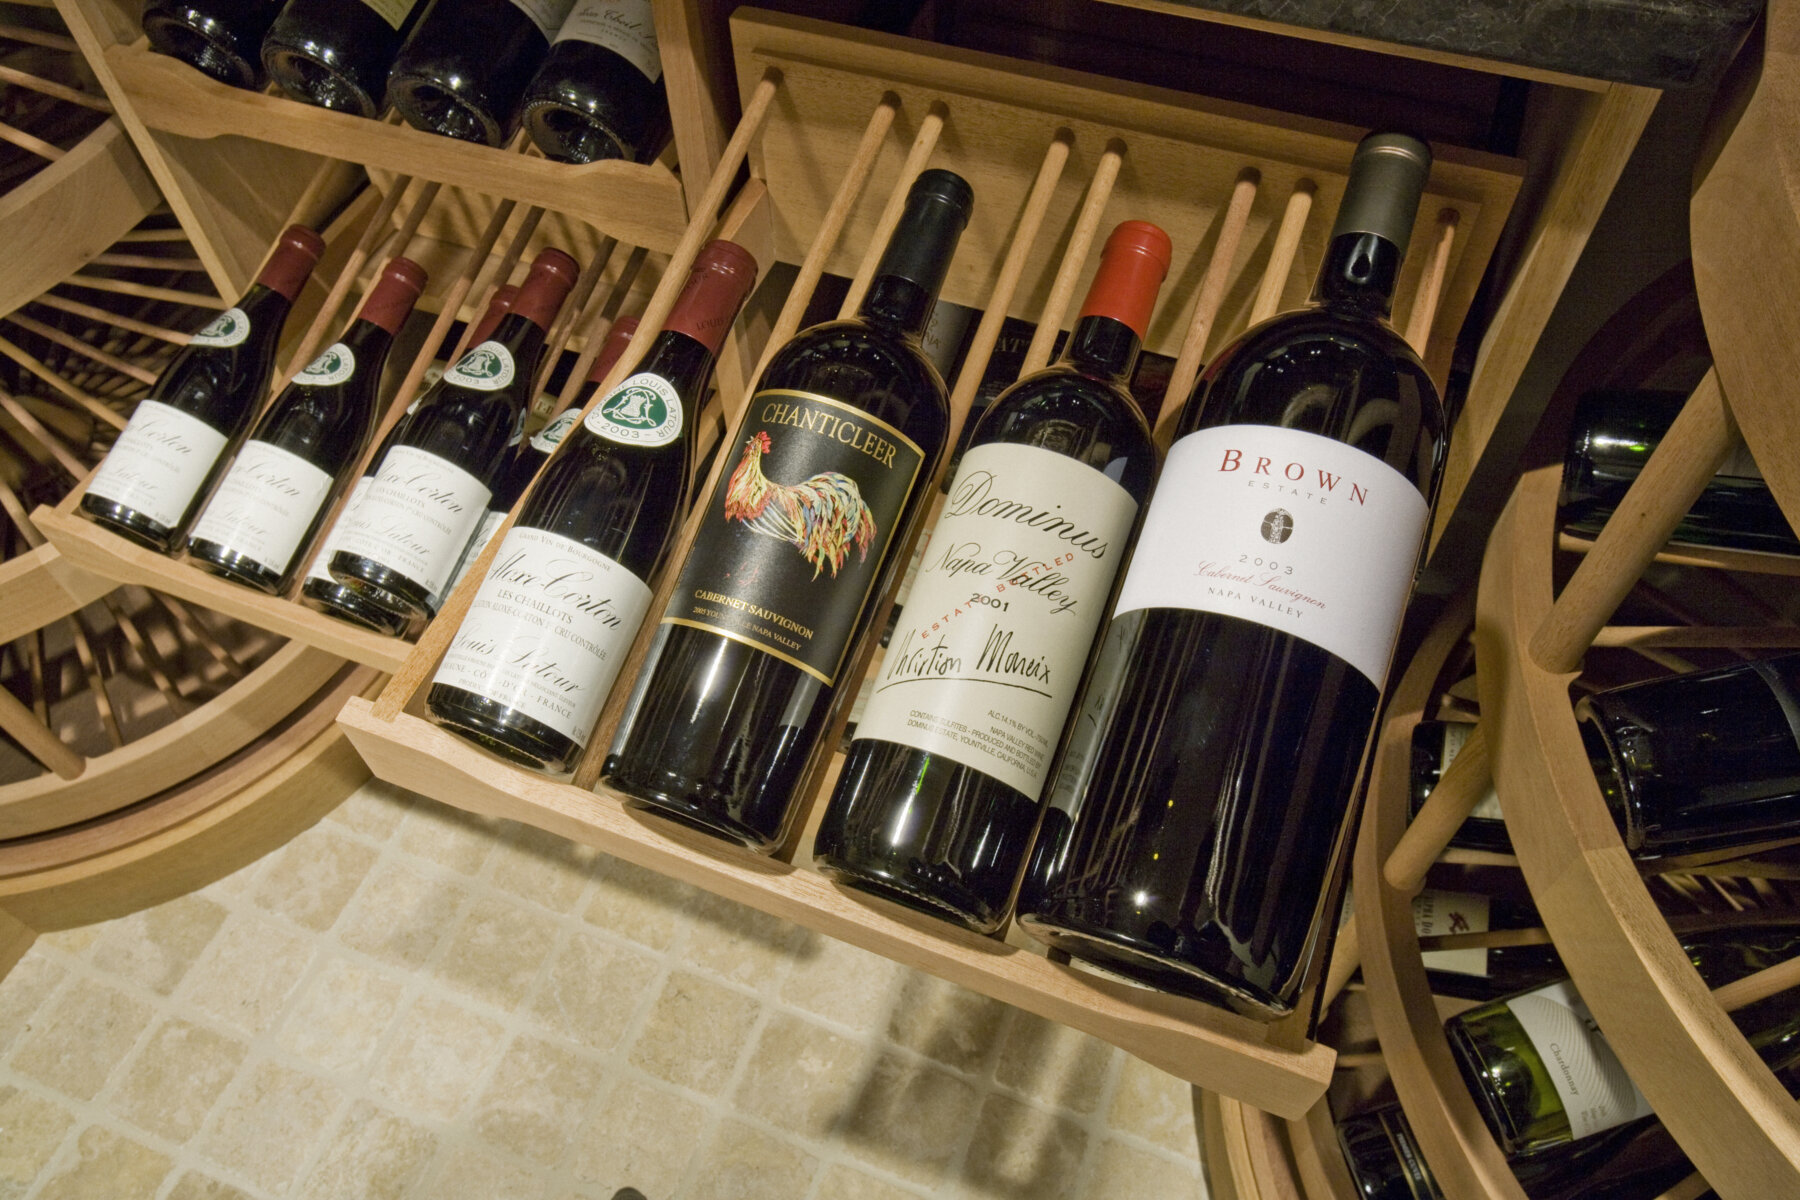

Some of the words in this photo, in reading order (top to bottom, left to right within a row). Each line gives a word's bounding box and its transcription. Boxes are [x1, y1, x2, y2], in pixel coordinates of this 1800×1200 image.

[632, 377, 670, 397] LOUIS
[655, 397, 678, 439] LATOUR
[601, 422, 641, 439] 2003
[761, 402, 898, 470] CHANTICLEER
[1217, 448, 1369, 507] BROWN
[1247, 480, 1329, 505] ESTATE
[944, 470, 1109, 559] Dominus
[925, 541, 994, 578] Napa
[993, 549, 1079, 617] Valley
[995, 551, 1076, 594] BOTTLED
[1192, 559, 1255, 584] Cabernet
[1252, 571, 1327, 610] Sauvignon
[1238, 553, 1294, 576] 2003
[497, 588, 513, 601] LES
[514, 592, 575, 625] CHAILLOTS
[694, 588, 750, 613] CABERNET
[748, 603, 815, 641] SAUVIGNON
[968, 592, 1009, 613] 2001
[1207, 586, 1242, 601] NAPA
[1249, 594, 1304, 619] VALLEY
[751, 620, 773, 639] NAPA
[773, 630, 803, 652] VALLEY
[512, 634, 587, 694] Latour
[535, 694, 574, 721] FRANCE
[971, 728, 1005, 749] PRODUCED
[1004, 743, 1016, 755] AND
[990, 725, 1006, 739] NAPA
[1006, 733, 1025, 749] VALLEY
[1550, 1042, 1580, 1097] Chardonnay
